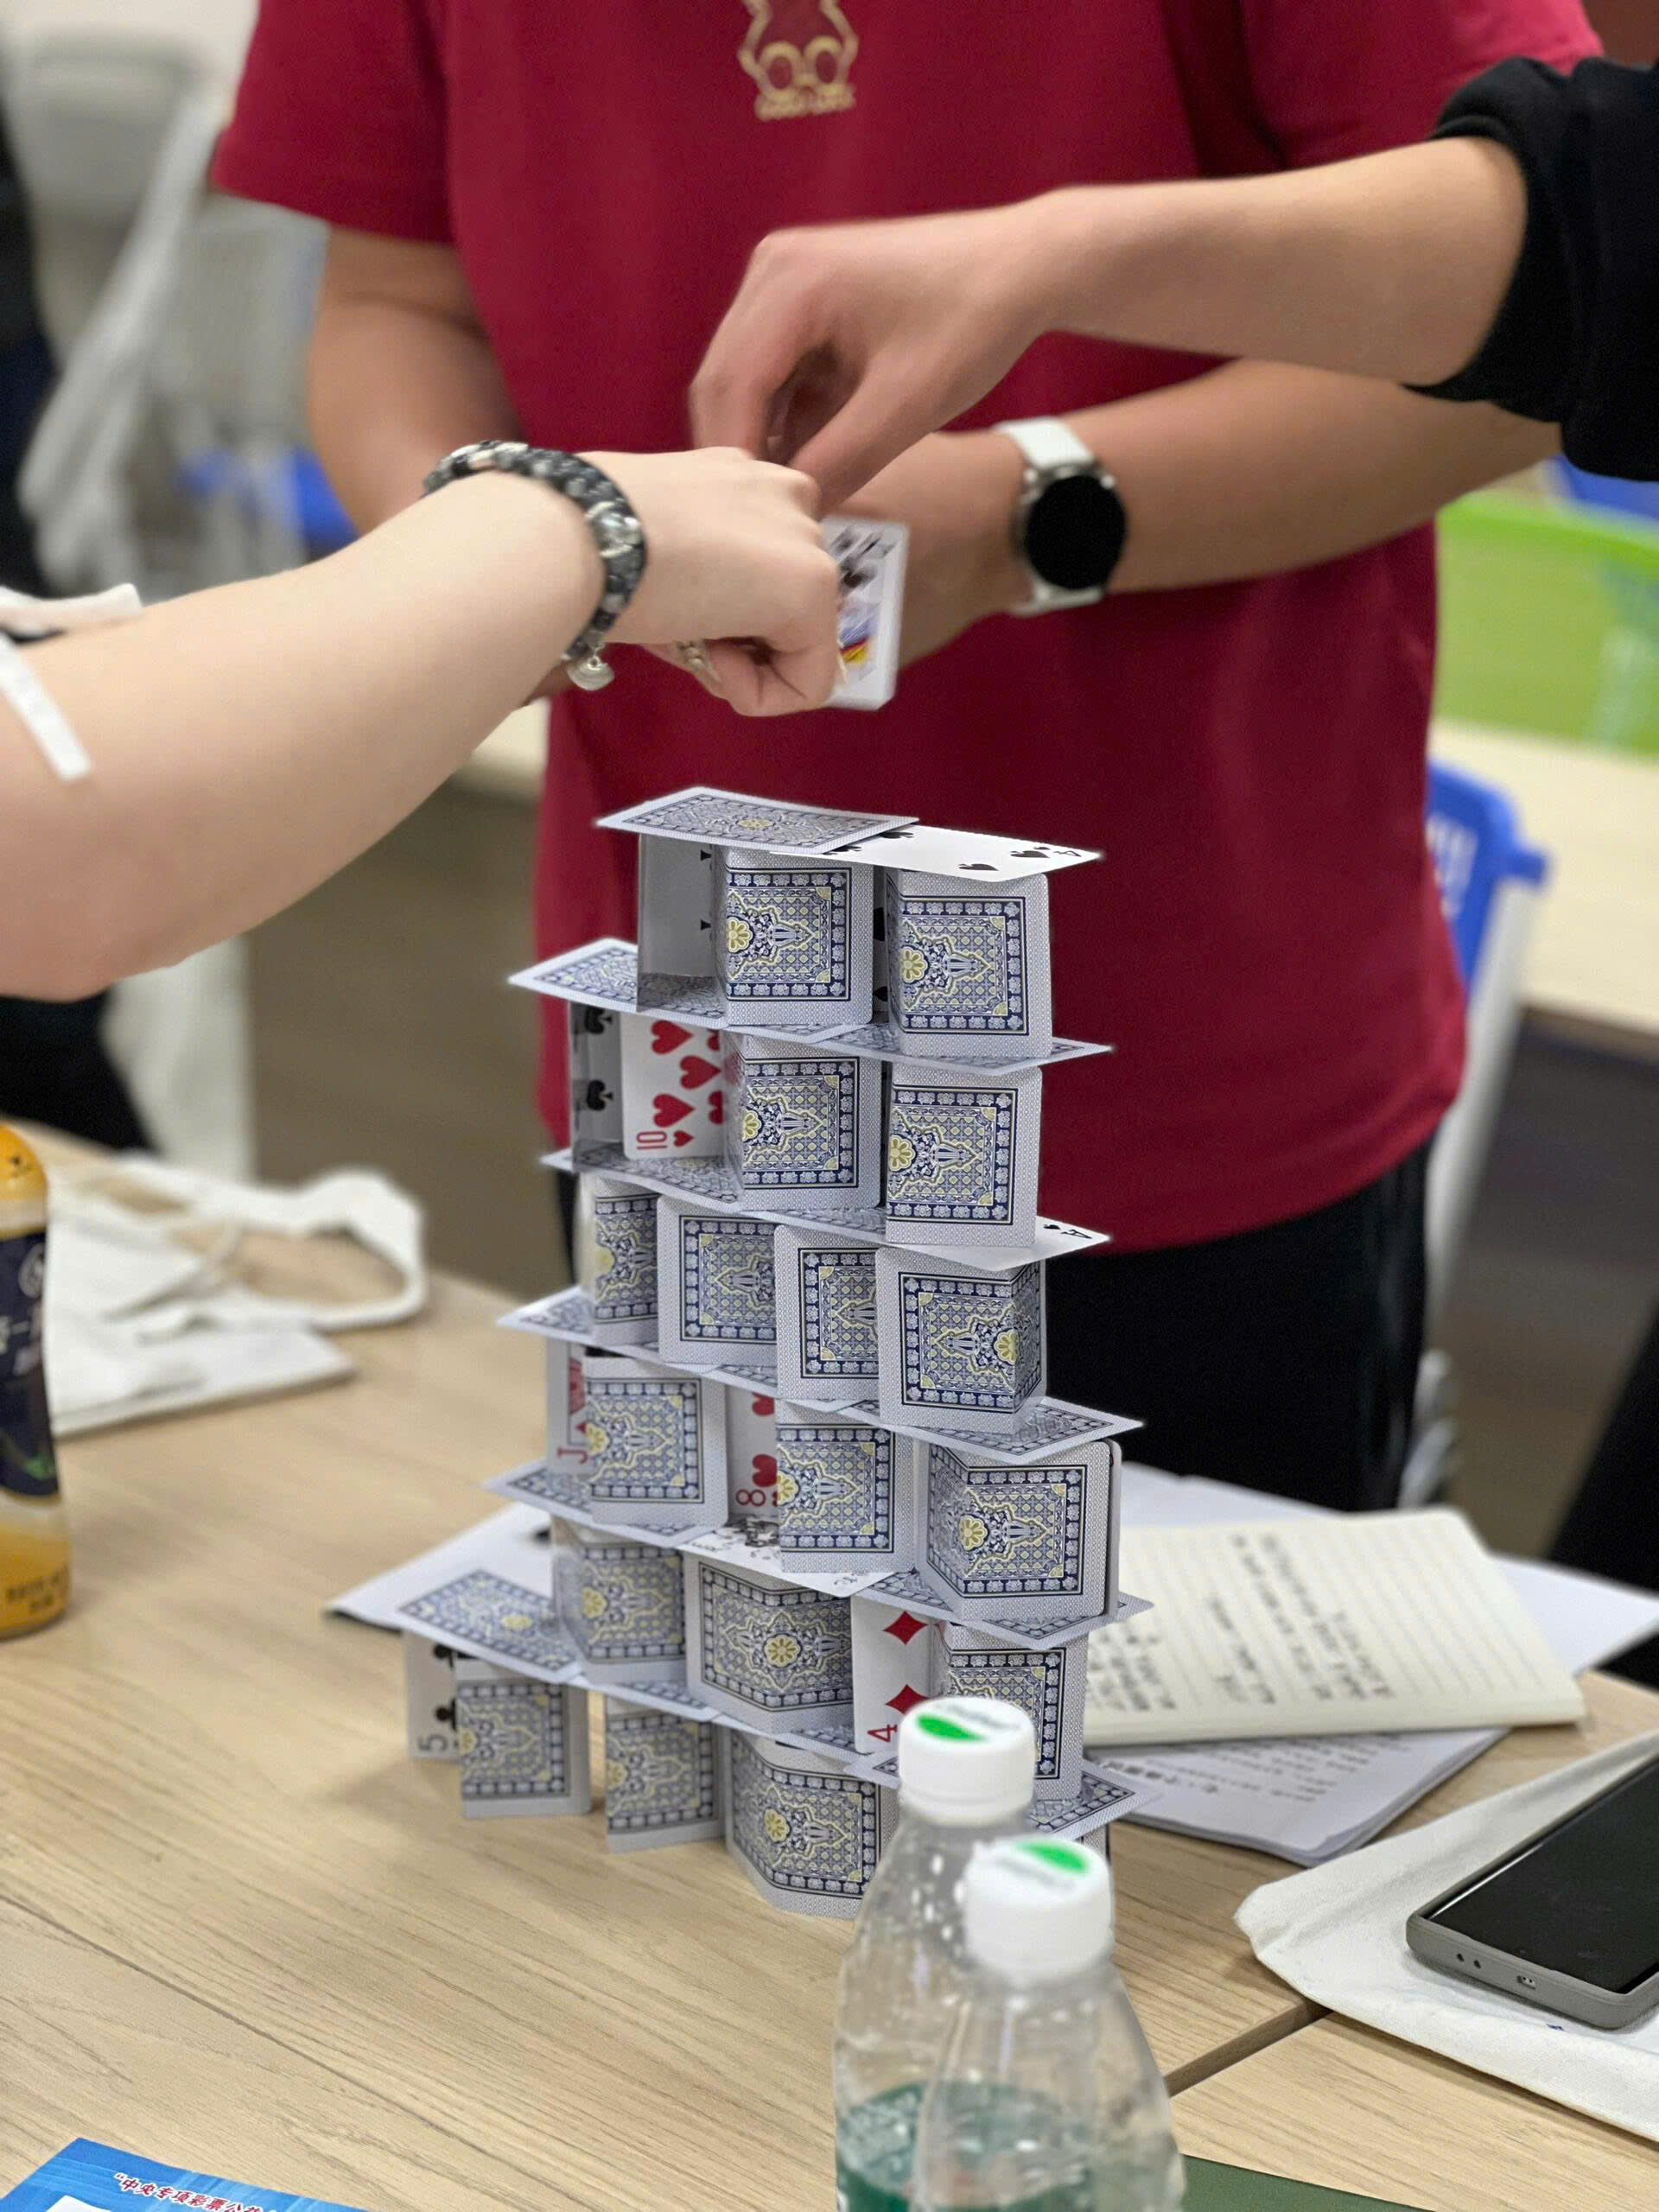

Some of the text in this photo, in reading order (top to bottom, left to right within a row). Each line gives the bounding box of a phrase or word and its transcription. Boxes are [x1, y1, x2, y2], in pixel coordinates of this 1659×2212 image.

[636, 1130, 668, 1151] 10
[1060, 1229, 1093, 1240] A
[556, 1446, 588, 1465] J
[735, 1488, 766, 1507] 8
[416, 1734, 448, 1752] 5
[867, 1724, 898, 1743] 4
